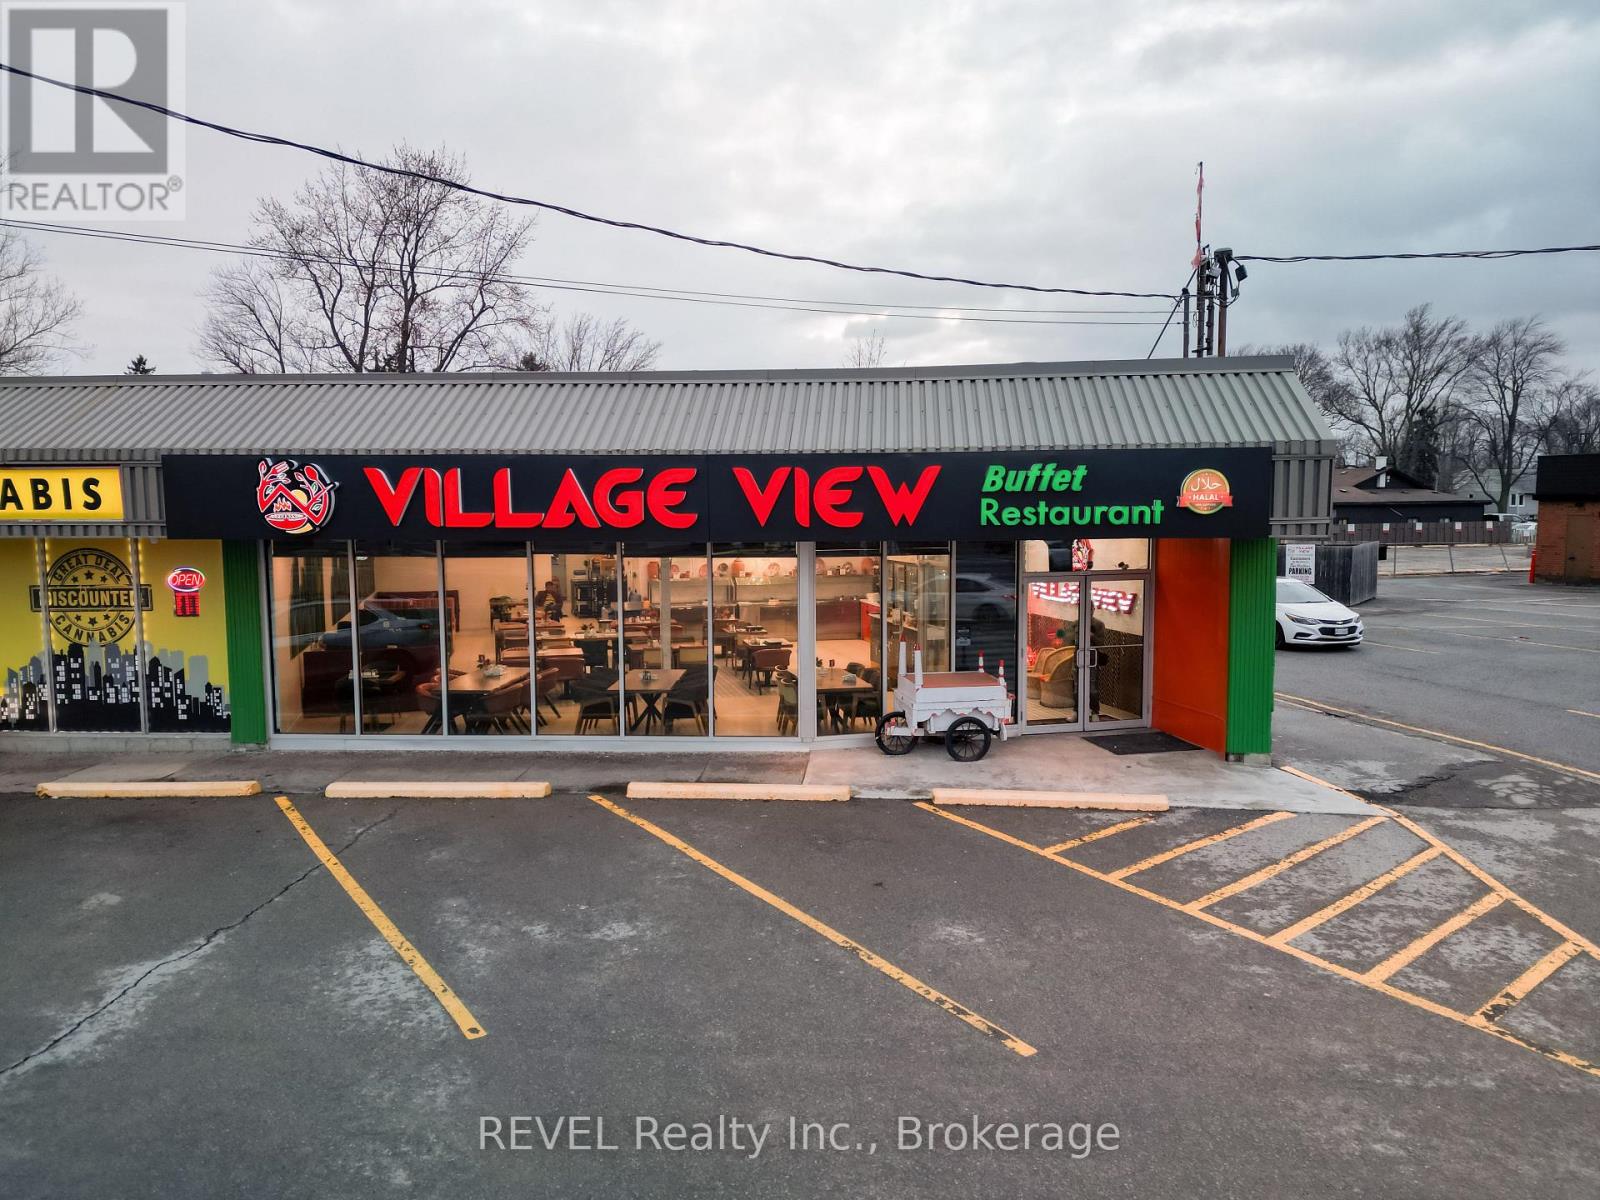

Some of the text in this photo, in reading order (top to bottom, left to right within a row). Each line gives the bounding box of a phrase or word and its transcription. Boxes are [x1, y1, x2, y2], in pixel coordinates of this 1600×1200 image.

[981, 462, 1088, 492] Buffet
[1190, 476, 1222, 492] حلال
[0, 477, 102, 511] ABIS
[363, 465, 942, 529] VILLAGE VIEW
[1192, 493, 1220, 501] HALAL
[980, 497, 1165, 527] Restaurant
[53, 553, 128, 582] GREAT DEAL
[172, 573, 201, 586] OPEN
[1288, 567, 1312, 575] PARKING
[55, 613, 131, 643] CANNABIS
